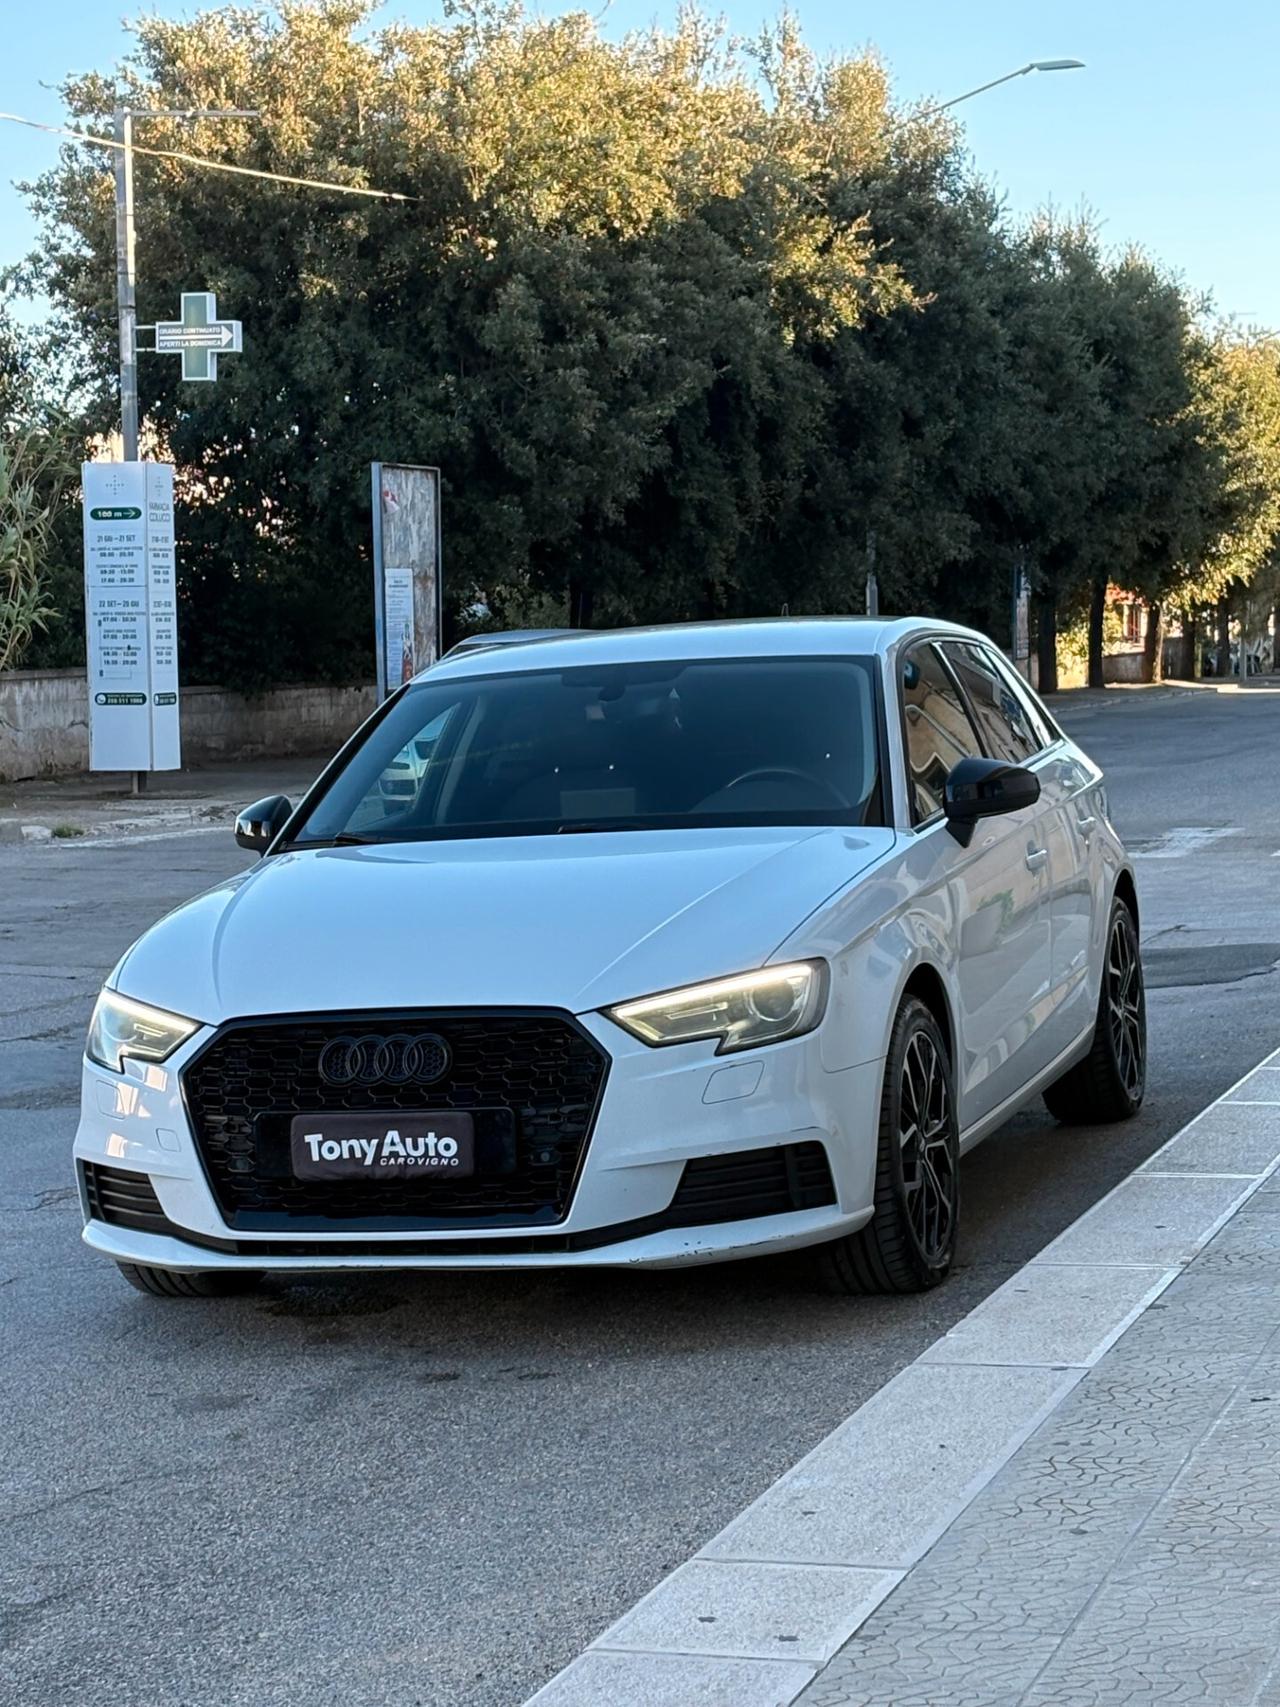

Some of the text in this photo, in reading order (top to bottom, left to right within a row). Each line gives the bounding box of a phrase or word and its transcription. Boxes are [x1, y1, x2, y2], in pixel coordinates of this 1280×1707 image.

[183, 326, 220, 334] CONTINUATO
[97, 510, 113, 518] 100
[304, 1130, 458, 1166] Tony Auto
[380, 1157, 459, 1167] CAROVIGNO
